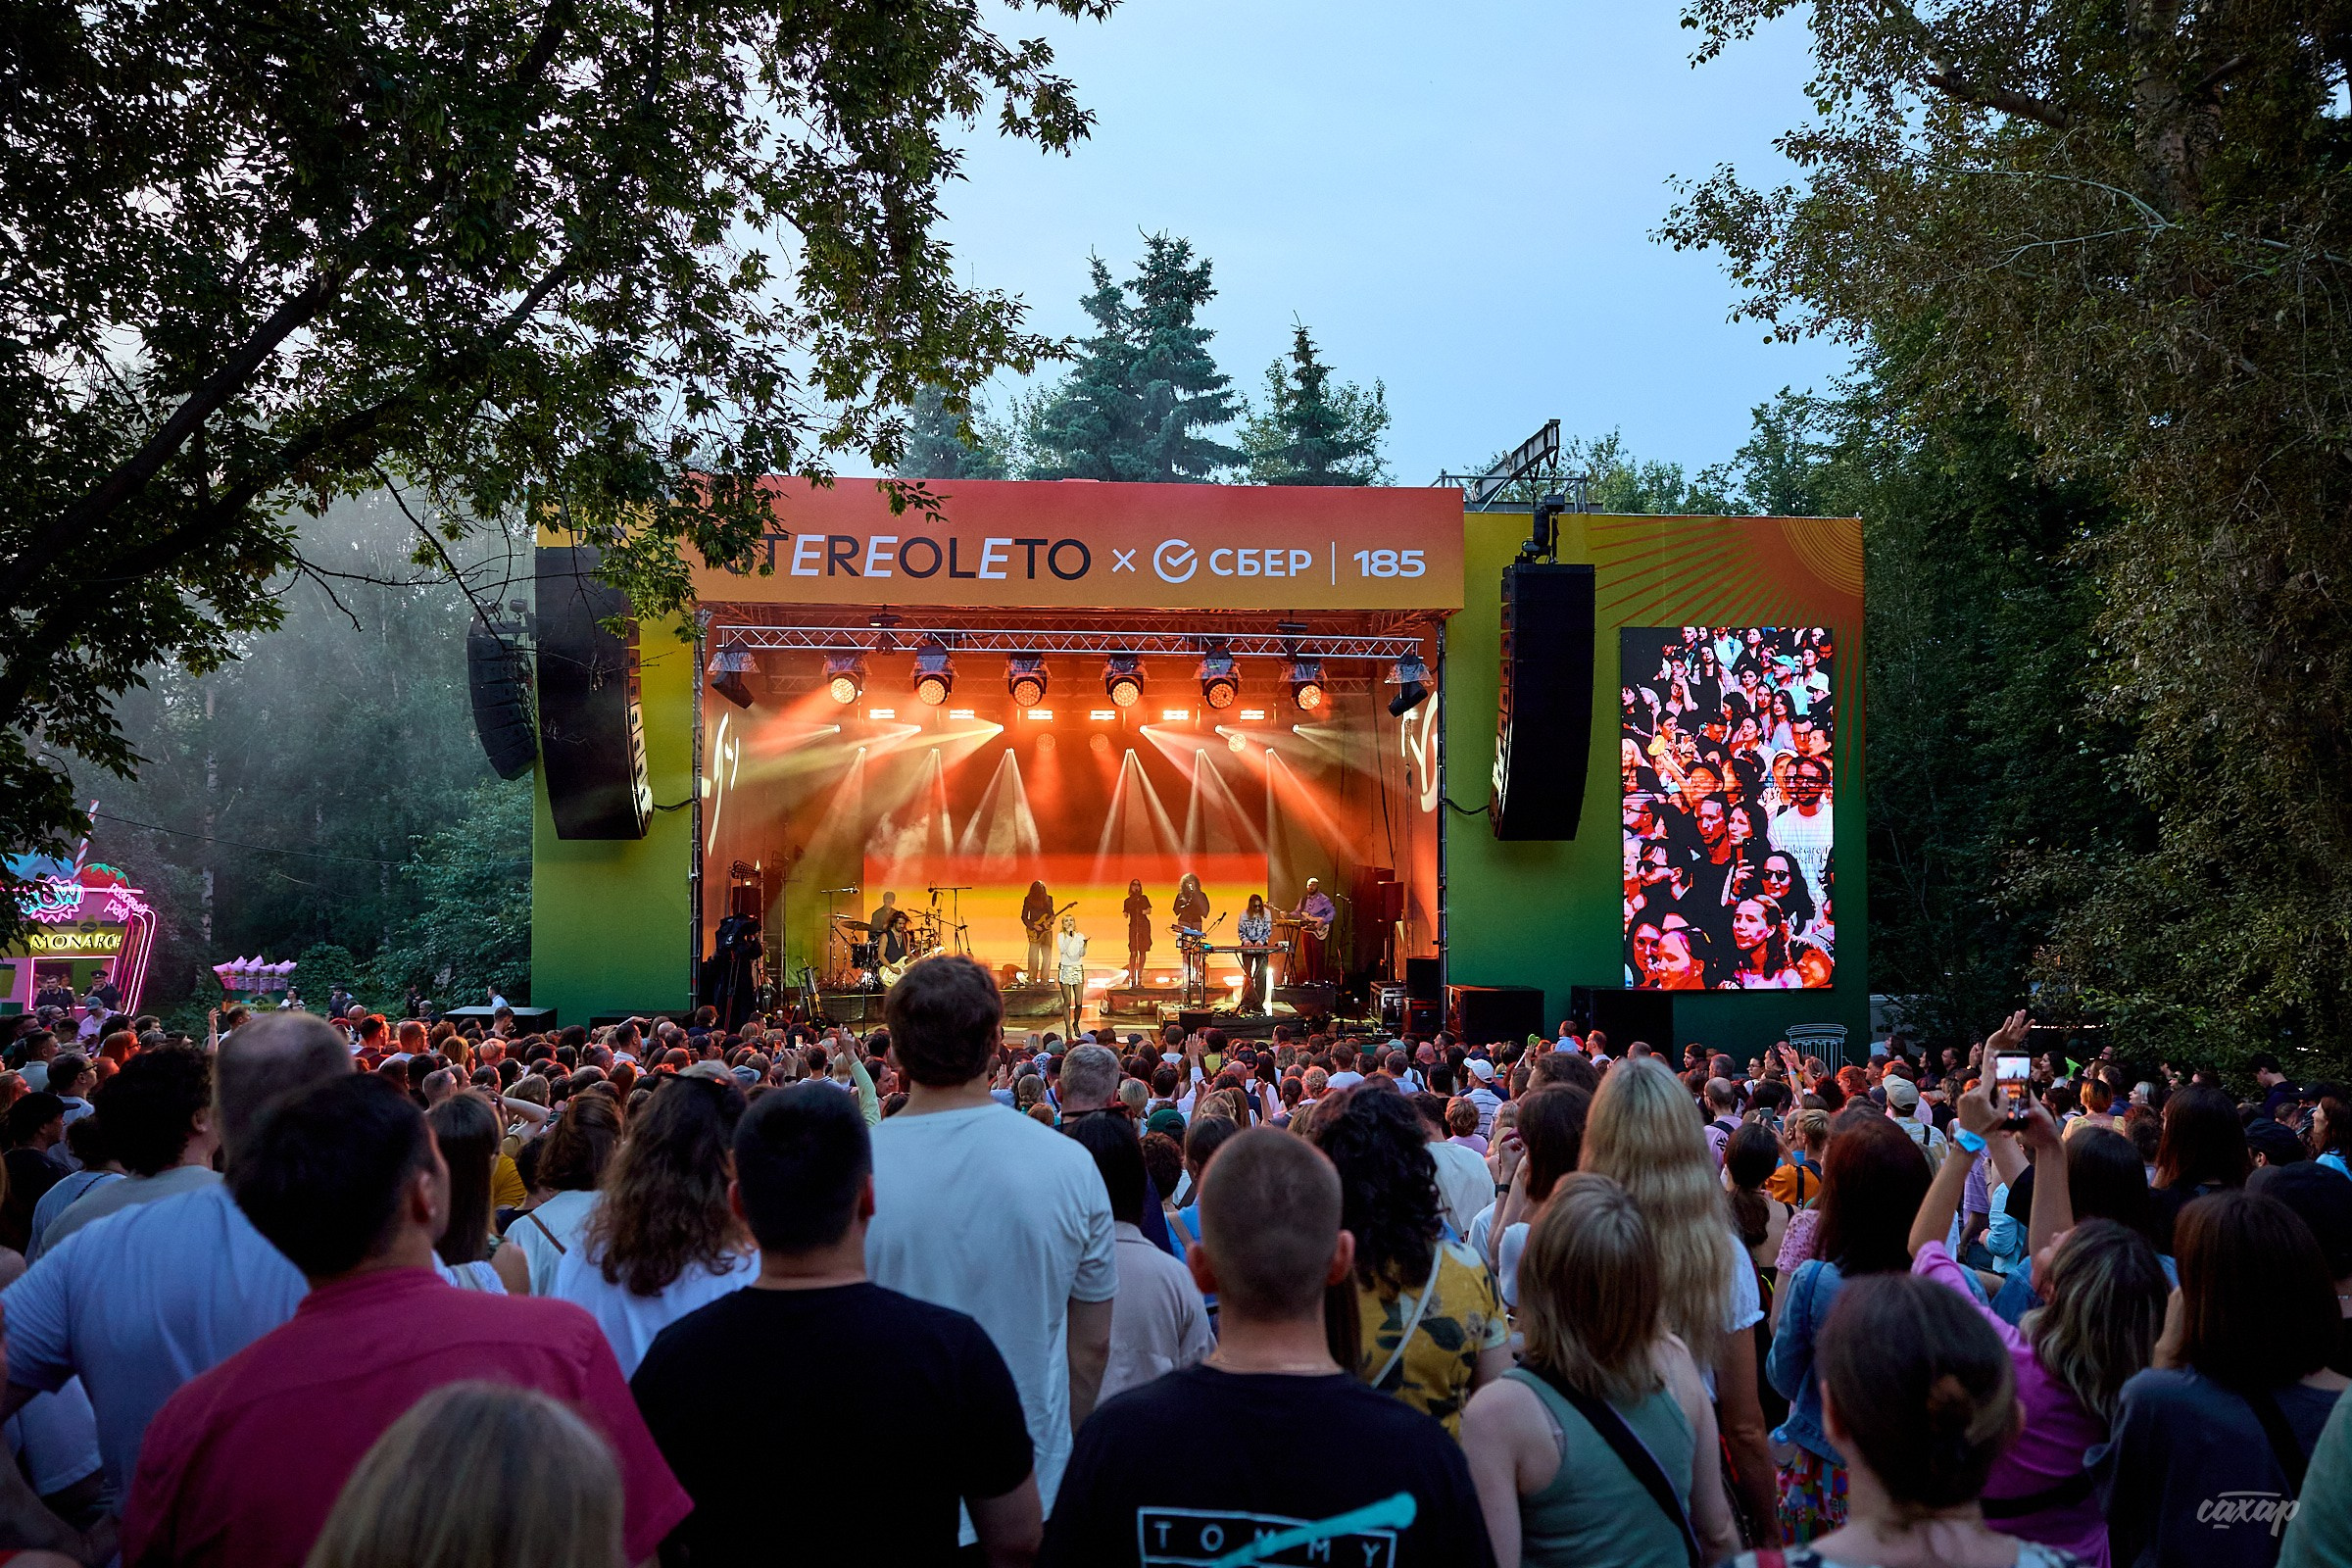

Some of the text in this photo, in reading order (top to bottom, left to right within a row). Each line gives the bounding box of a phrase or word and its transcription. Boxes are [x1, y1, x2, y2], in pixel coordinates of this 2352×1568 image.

[1208, 548, 1312, 576] СБЕР
[1353, 549, 1427, 578] 185
[103, 899, 130, 923] раф
[30, 934, 123, 950] MONARCH
